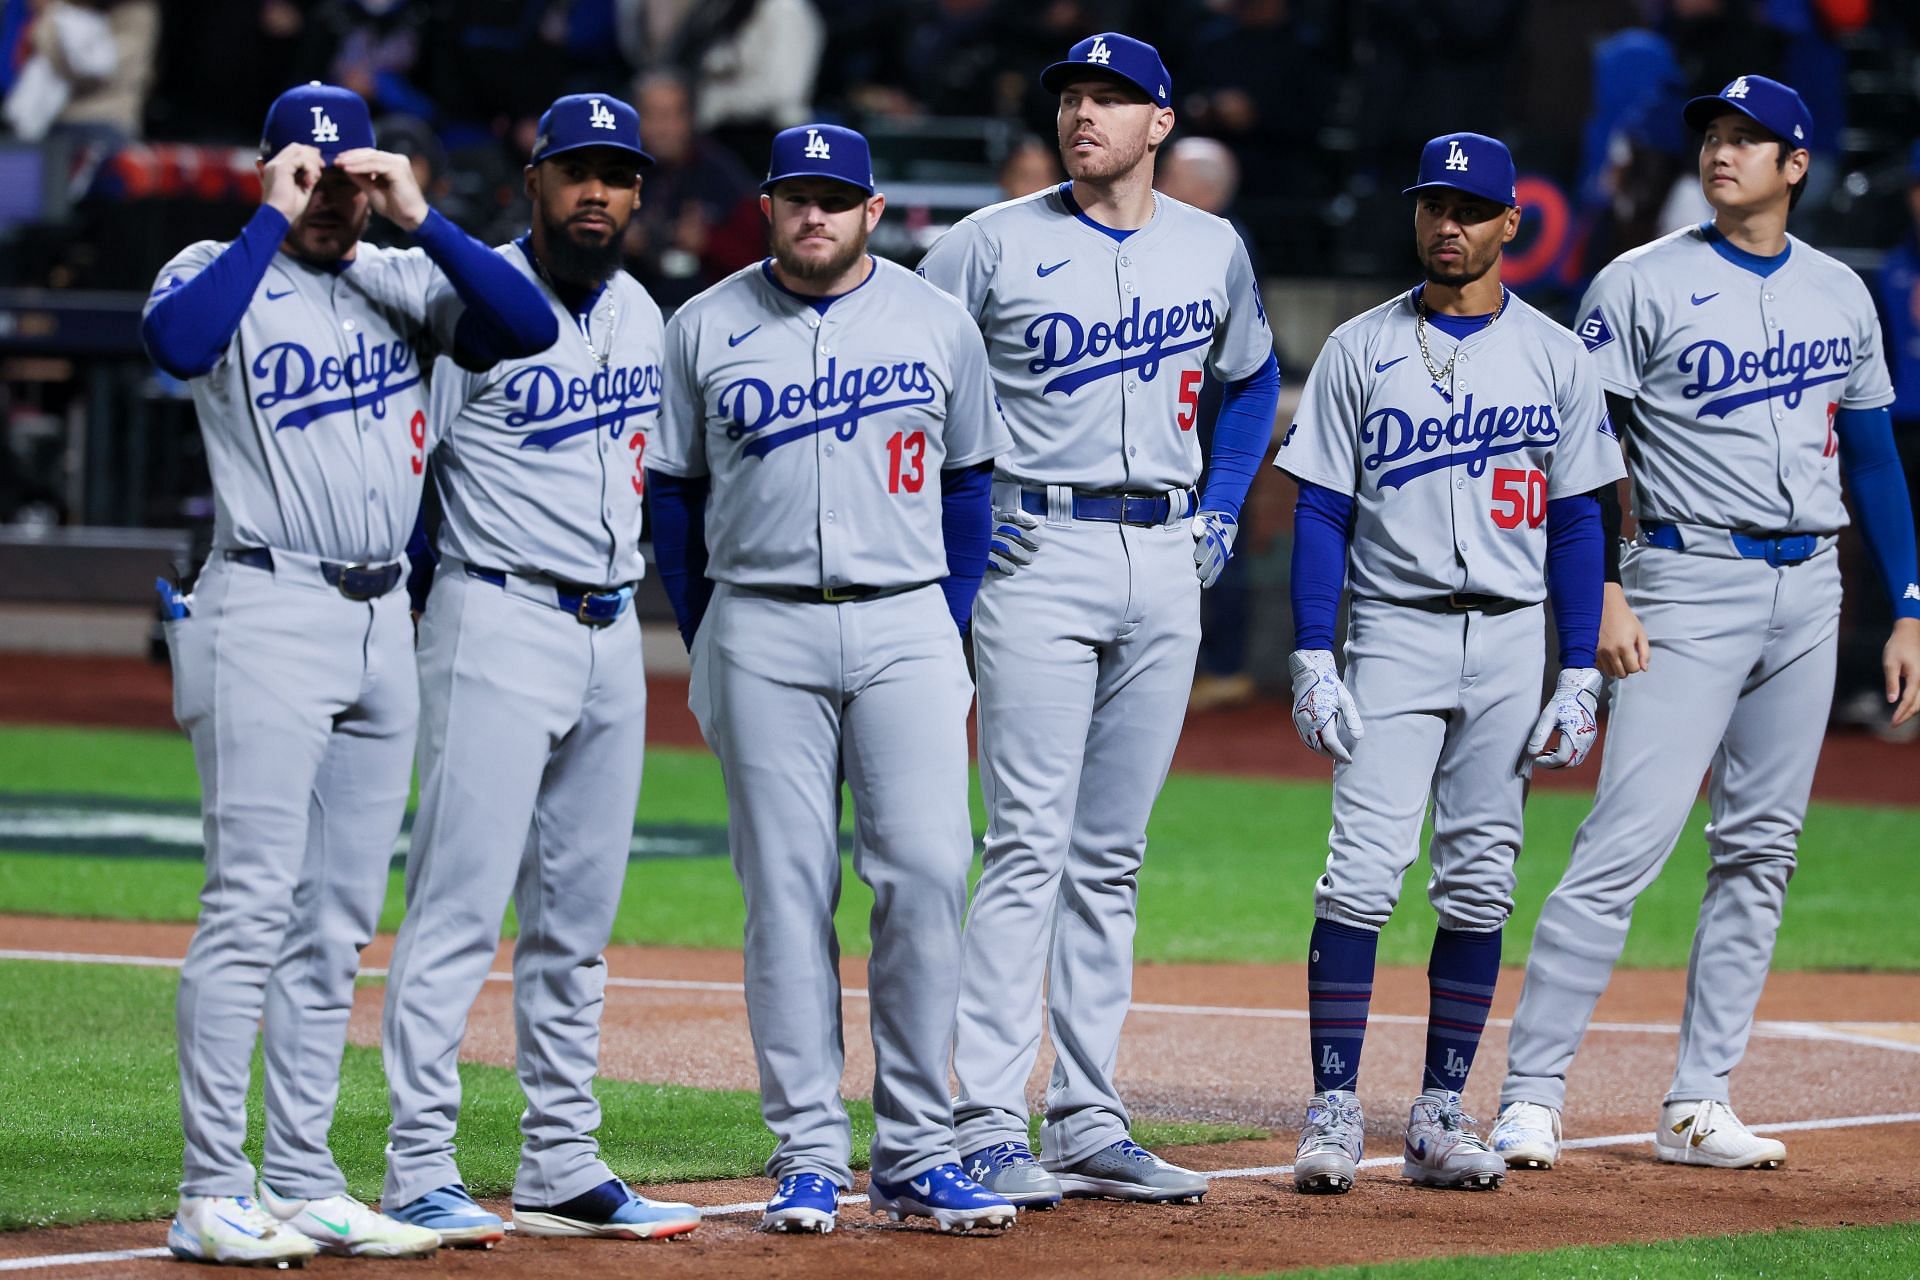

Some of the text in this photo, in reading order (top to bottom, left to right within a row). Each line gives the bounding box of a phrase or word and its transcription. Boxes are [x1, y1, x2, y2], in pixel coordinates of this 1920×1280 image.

[1086, 36, 1112, 65] LA
[589, 99, 616, 130] LA
[1726, 76, 1751, 101] LA
[311, 106, 339, 142] LA
[804, 128, 832, 160] LA
[1445, 140, 1469, 171] LA
[1025, 297, 1215, 382] Dodgers
[1676, 330, 1852, 410] Dodgers
[252, 332, 412, 420] Dodge
[717, 356, 936, 442] Dodgers
[1177, 370, 1203, 431] 5
[410, 409, 426, 476] 9
[886, 431, 926, 494] 13
[1361, 391, 1560, 474] Dodgers
[1490, 468, 1547, 530] 50
[1320, 1045, 1346, 1075] LA
[1444, 1048, 1469, 1078] LA
